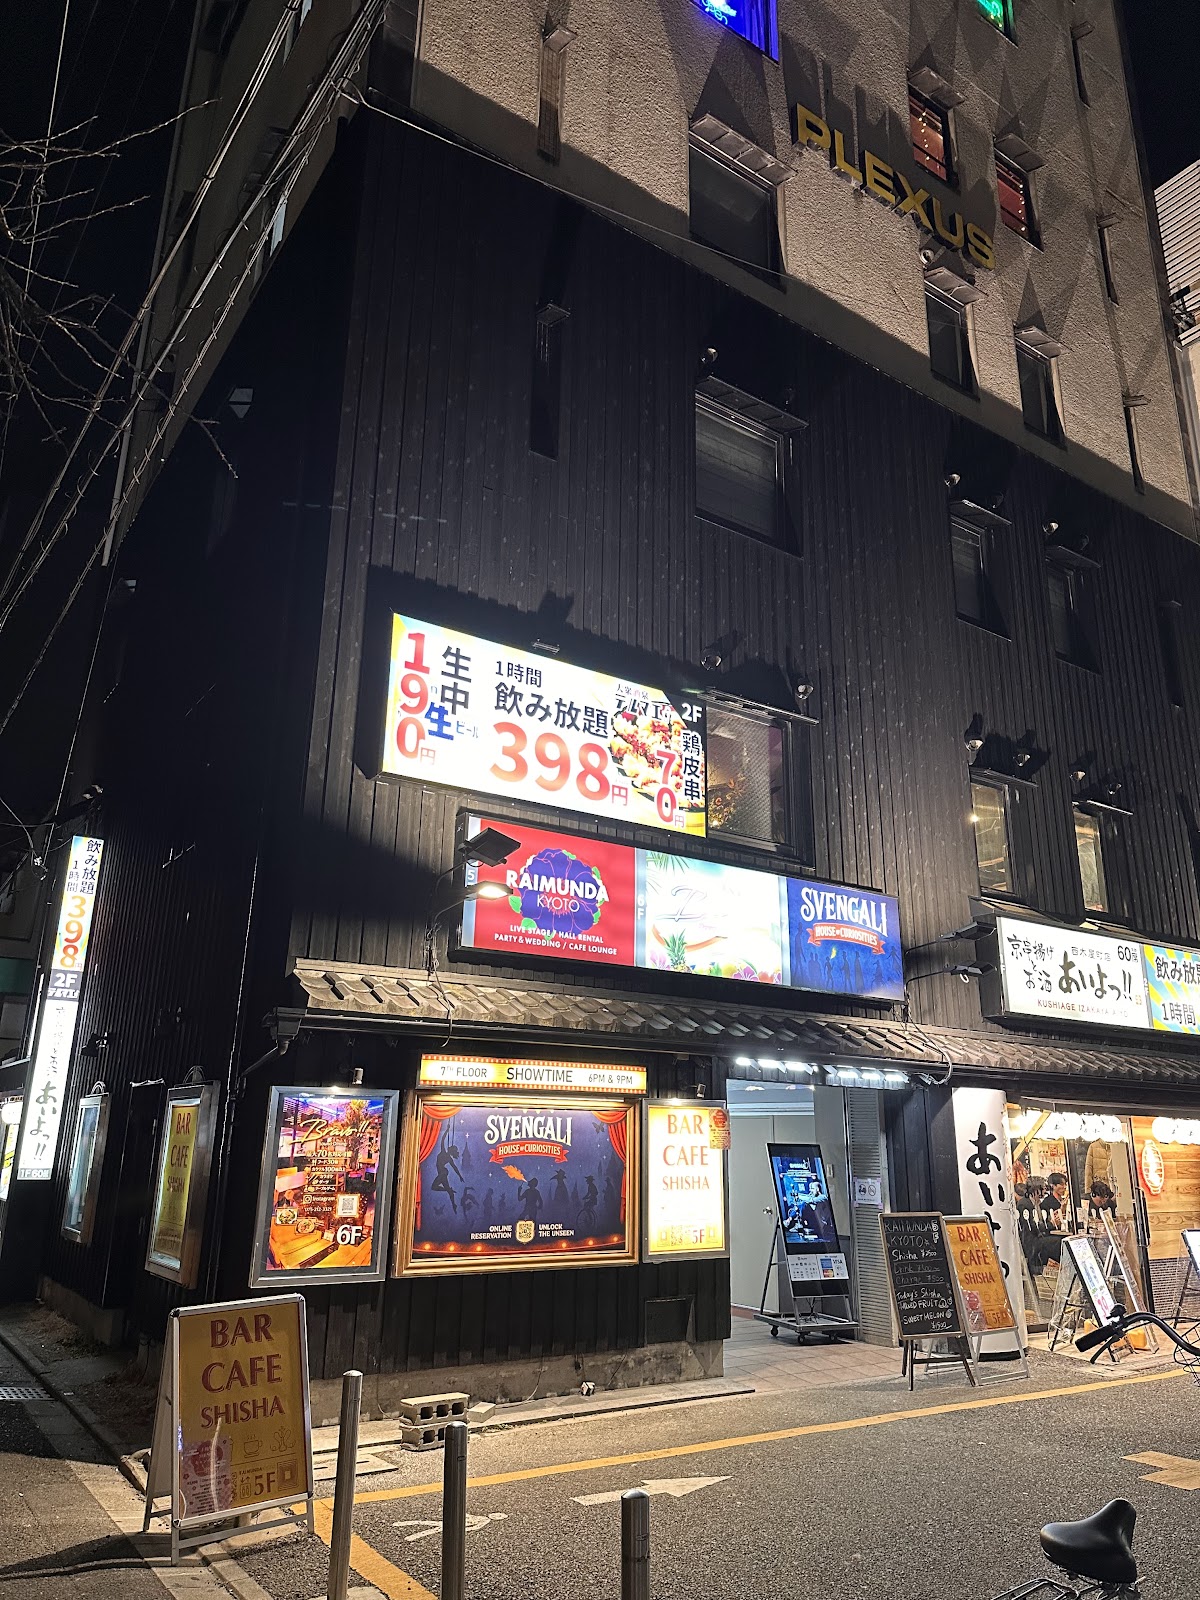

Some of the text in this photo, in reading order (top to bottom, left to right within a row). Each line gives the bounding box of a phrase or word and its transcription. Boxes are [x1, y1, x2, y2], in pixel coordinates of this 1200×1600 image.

[796, 102, 995, 270] PLEXUS
[441, 646, 472, 715] 生中
[495, 659, 542, 688] 1時間
[494, 681, 609, 739] 飲み放題
[681, 702, 703, 723] 2F
[682, 732, 701, 801] 鶏皮串
[66, 860, 80, 893] 1時間
[79, 839, 102, 895] 飲み放題
[506, 869, 609, 902] RAIMUNDA
[536, 894, 580, 913] KYOTO
[800, 886, 889, 938] SVENGALI
[494, 933, 518, 944] PARTY
[525, 937, 561, 949] WEDDING
[568, 943, 587, 952] CAFE
[587, 945, 618, 956] LOUNGE
[509, 924, 528, 935] LIVE
[528, 926, 551, 937] STAGE
[558, 931, 577, 941] HALL
[577, 933, 604, 944] RENTAL
[815, 925, 837, 938] HOUSE
[840, 927, 878, 946] CURIOSITIES
[54, 972, 79, 989] 2F
[1023, 969, 1053, 993] お酒
[1037, 998, 1076, 1012] KUSHIAGE
[1078, 1004, 1109, 1015] IZAKAYA
[1162, 1002, 1197, 1027] 1時間
[456, 1066, 488, 1079] FLOOR
[506, 1067, 573, 1083] SHOWTIME
[588, 1073, 606, 1084] 6PM
[607, 1074, 614, 1084] &
[616, 1074, 633, 1085] 9PM
[176, 1112, 191, 1135] BAR
[484, 1114, 573, 1147] SVENGALI
[667, 1114, 704, 1135] BAR
[170, 1144, 188, 1168] CAFE
[498, 1144, 520, 1156] HOUSE
[524, 1143, 561, 1155] CURIOSITIES
[662, 1145, 709, 1167] CAFE
[166, 1175, 185, 1193] SHISHA
[662, 1175, 710, 1191] SHISHA
[336, 1224, 362, 1245] 6F
[470, 1231, 512, 1241] RESERVATION
[489, 1225, 513, 1233] ONLINE
[538, 1223, 563, 1231] UNLOCK
[538, 1229, 574, 1238] THE UNSEEN
[885, 1220, 932, 1232] RAIMUNDA
[956, 1225, 982, 1243] BAR
[890, 1235, 924, 1248] KYOTO
[892, 1249, 919, 1261] Shisha
[960, 1249, 990, 1266] CAFE
[964, 1272, 996, 1285] SHISHA
[920, 1287, 942, 1298] Shisha
[917, 1299, 939, 1309] FRUIT
[903, 1311, 945, 1325] SWEET MELON
[991, 1312, 1001, 1325] 5F
[210, 1313, 275, 1349] BAR
[201, 1354, 283, 1394] CAFE
[200, 1395, 286, 1429] SHISHA
[254, 1472, 276, 1496] 5F
